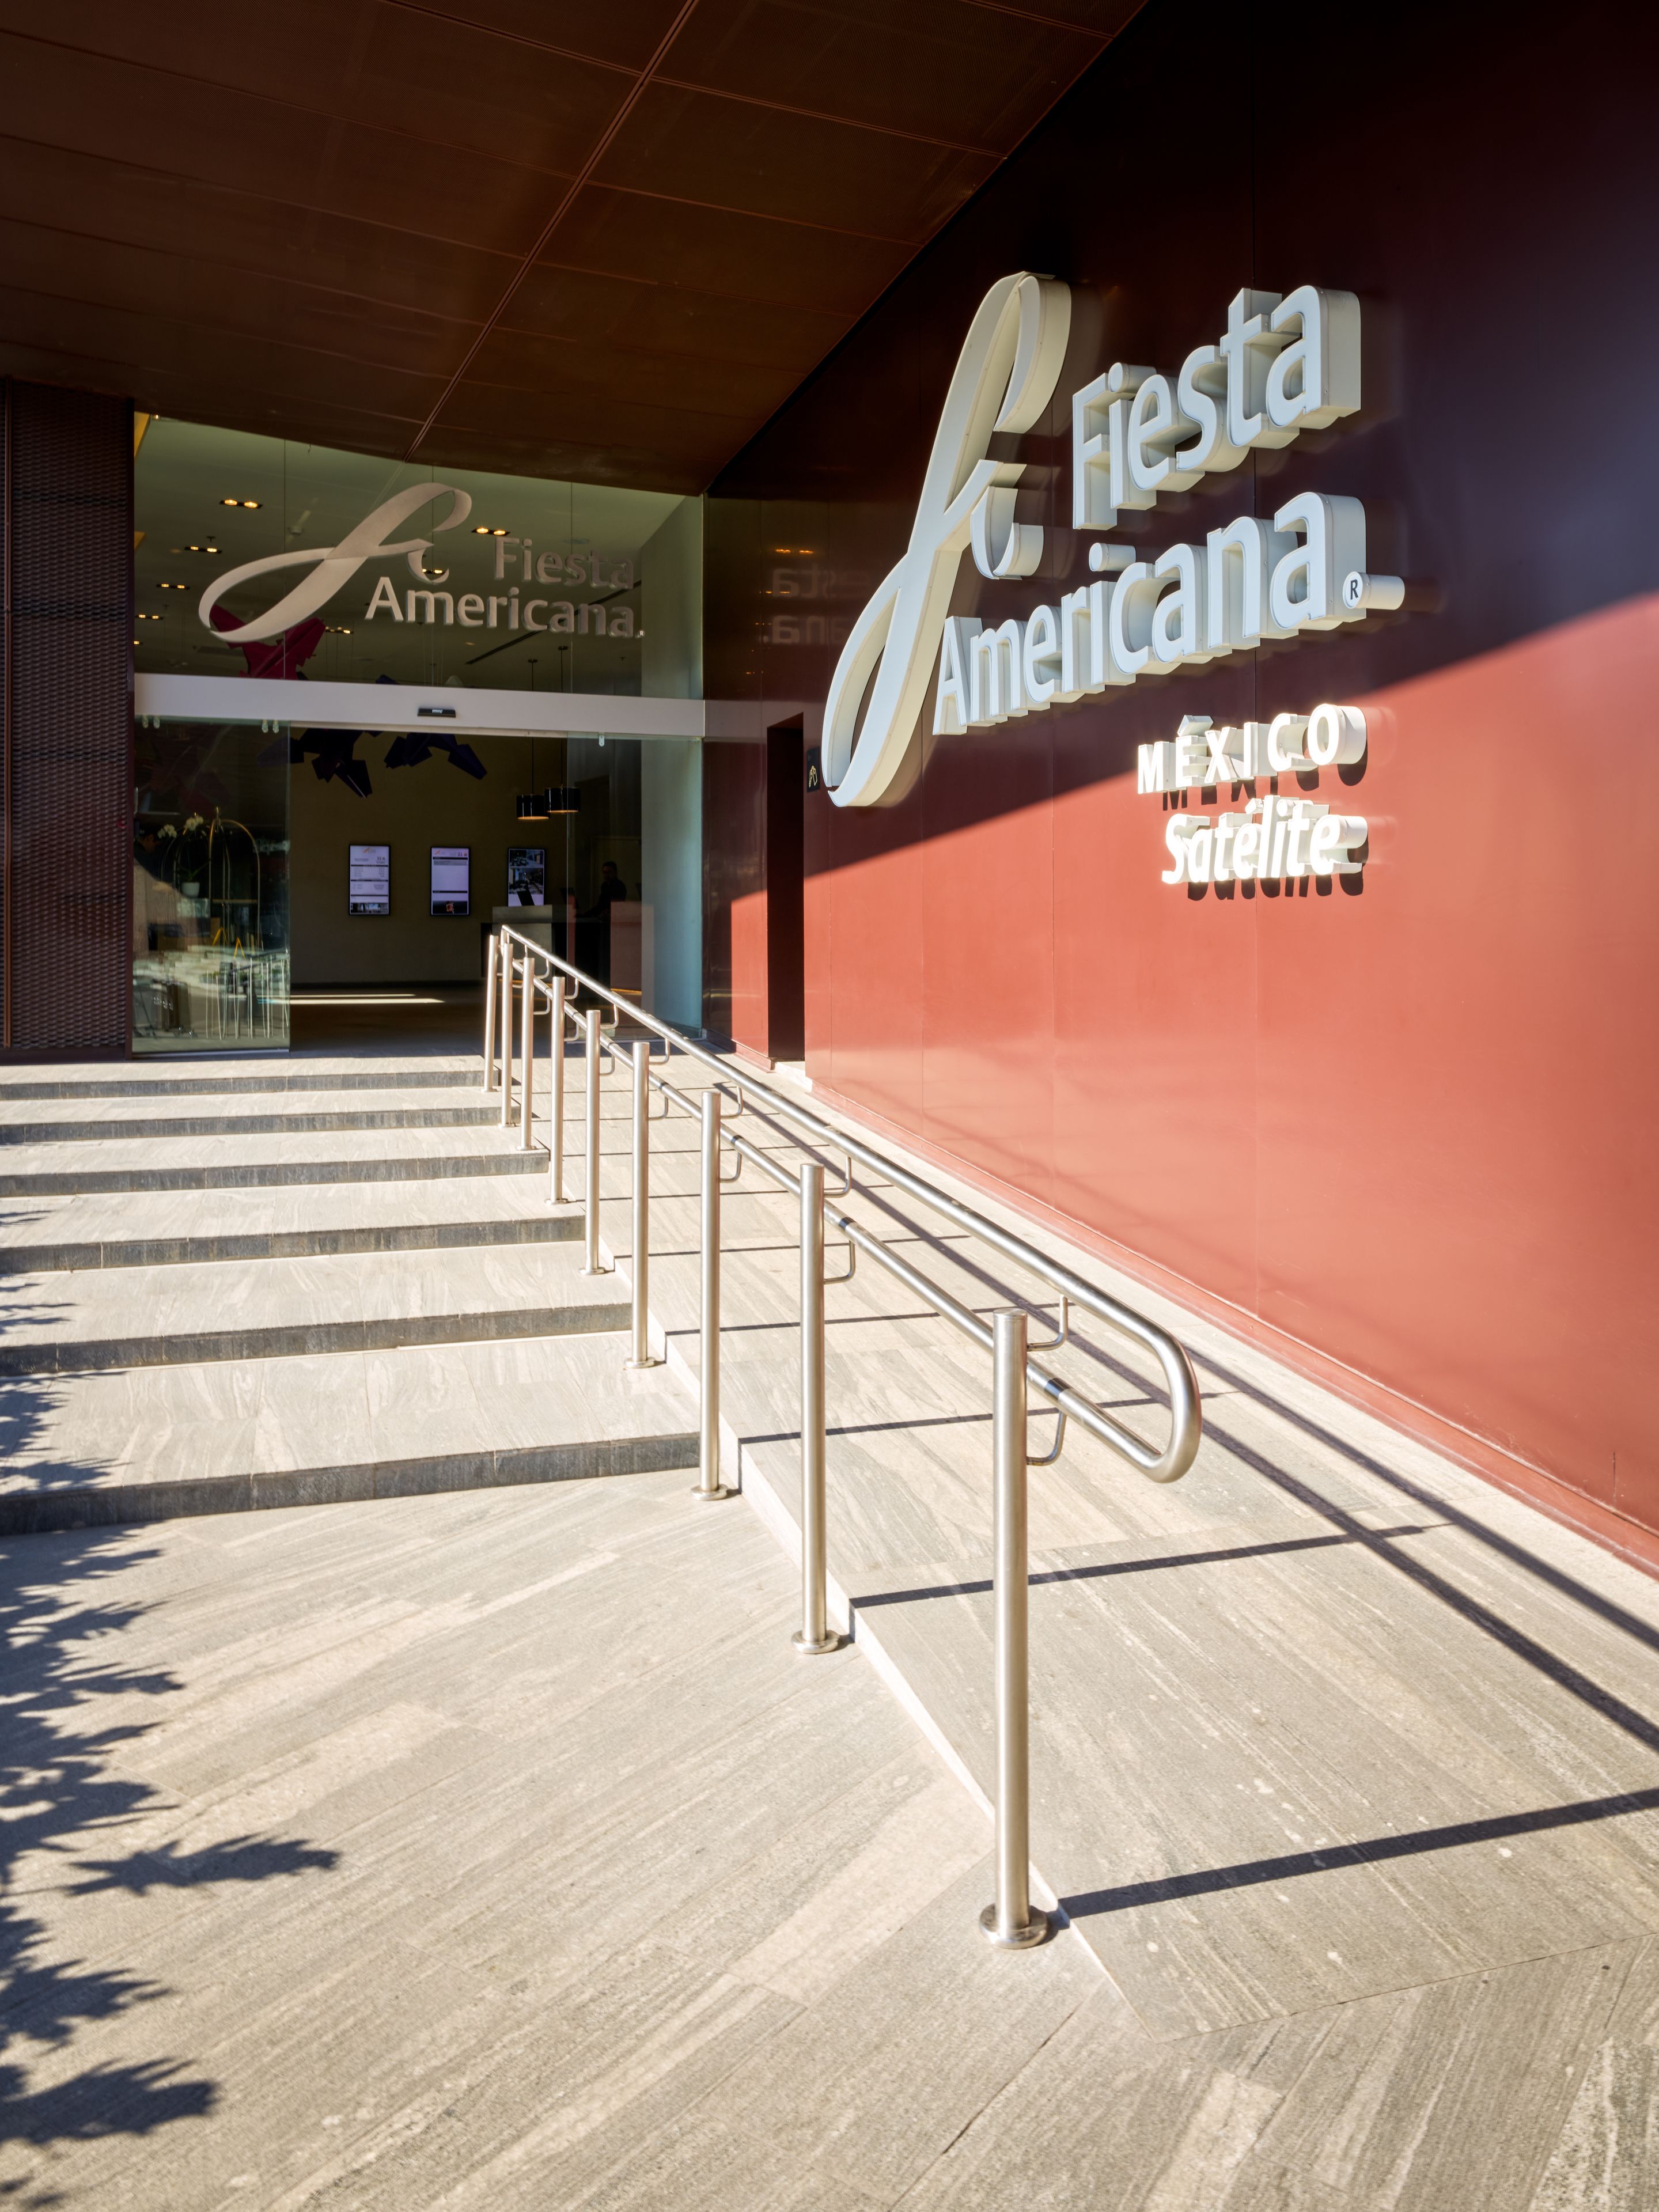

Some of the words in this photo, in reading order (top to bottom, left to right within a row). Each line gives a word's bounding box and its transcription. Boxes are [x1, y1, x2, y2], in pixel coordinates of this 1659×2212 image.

[1073, 286, 1361, 529] Fiesta
[494, 537, 633, 589] Fiesta
[1138, 703, 1367, 794] MÉXICO
[1161, 795, 1368, 884] Satélite
